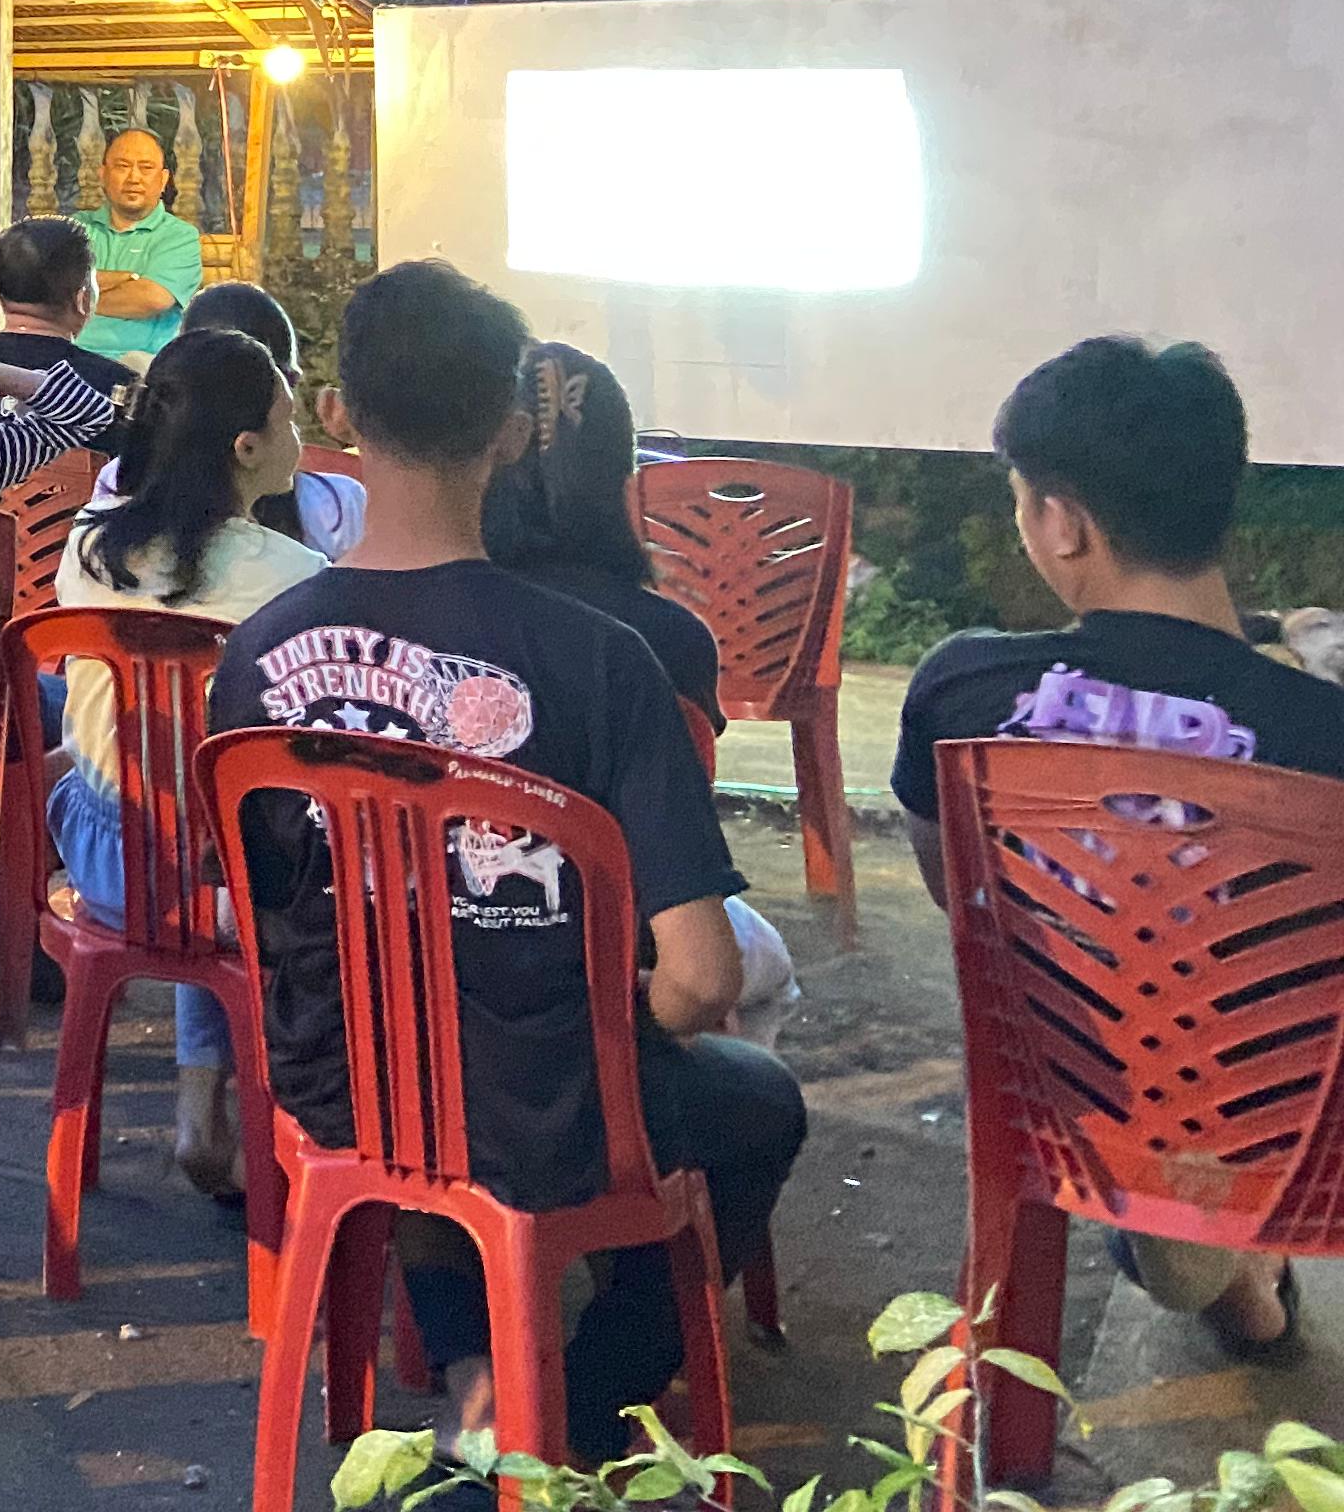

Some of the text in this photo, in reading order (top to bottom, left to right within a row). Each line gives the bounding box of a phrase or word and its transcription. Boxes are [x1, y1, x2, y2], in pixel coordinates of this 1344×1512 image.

[256, 626, 433, 685] UNITY IS
[261, 662, 439, 726] STRENGTH
